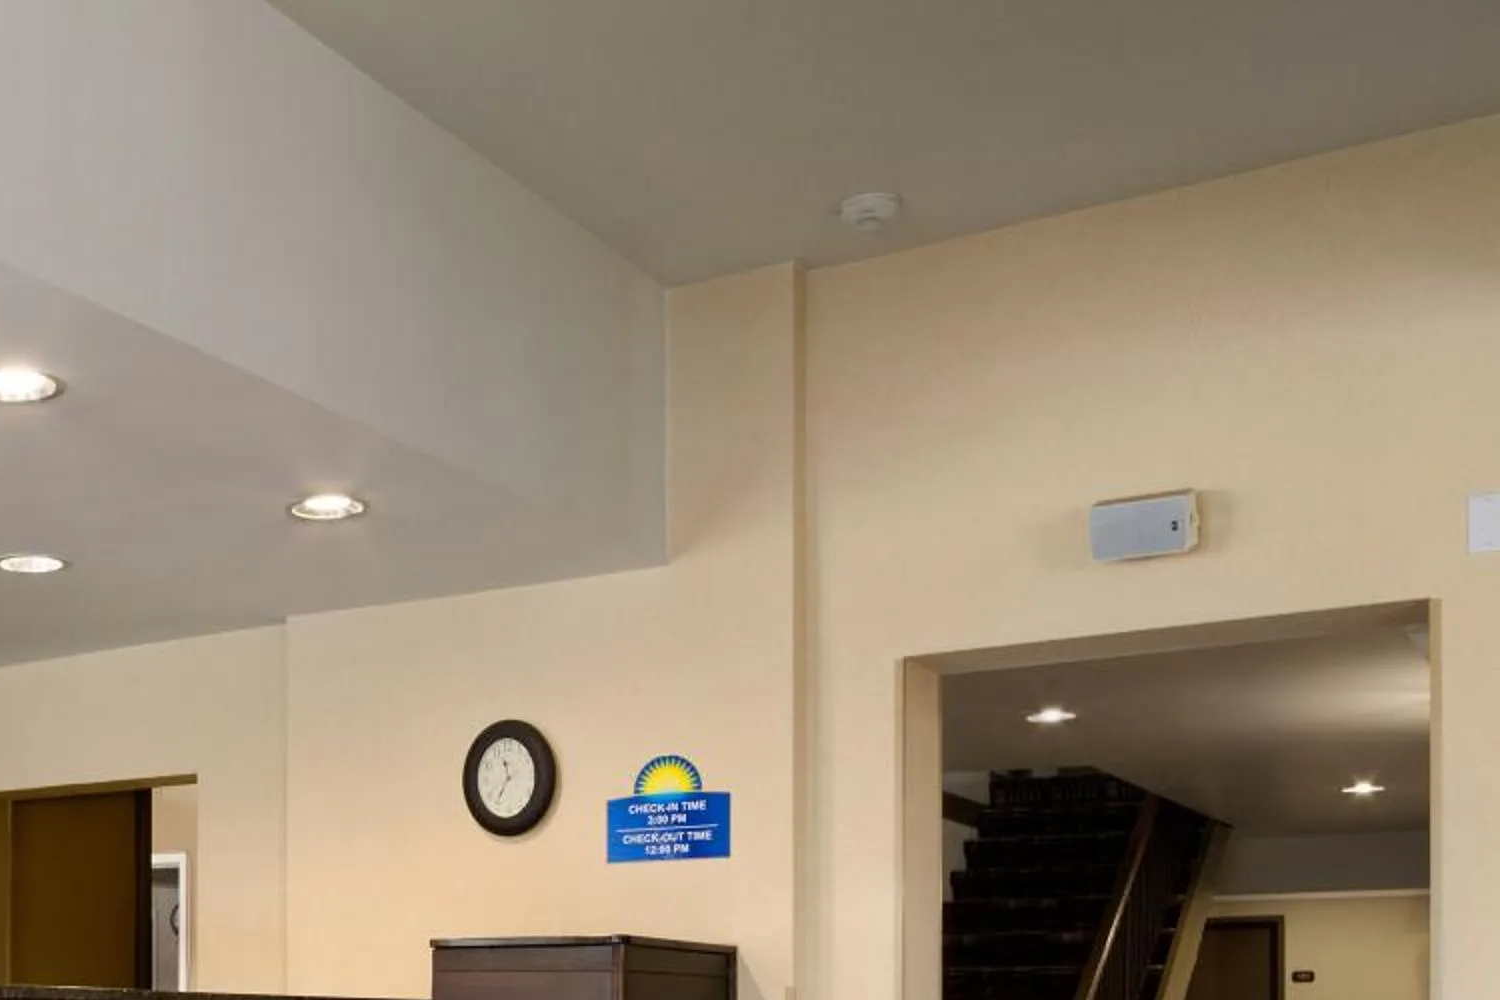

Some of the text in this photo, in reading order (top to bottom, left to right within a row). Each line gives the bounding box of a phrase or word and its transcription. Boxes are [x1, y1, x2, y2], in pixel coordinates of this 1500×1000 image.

[627, 800, 708, 815] CHECK-IN TIME
[671, 812, 687, 823] PM
[622, 830, 713, 845] CHECK-OUT TIME
[673, 843, 690, 854] PM
